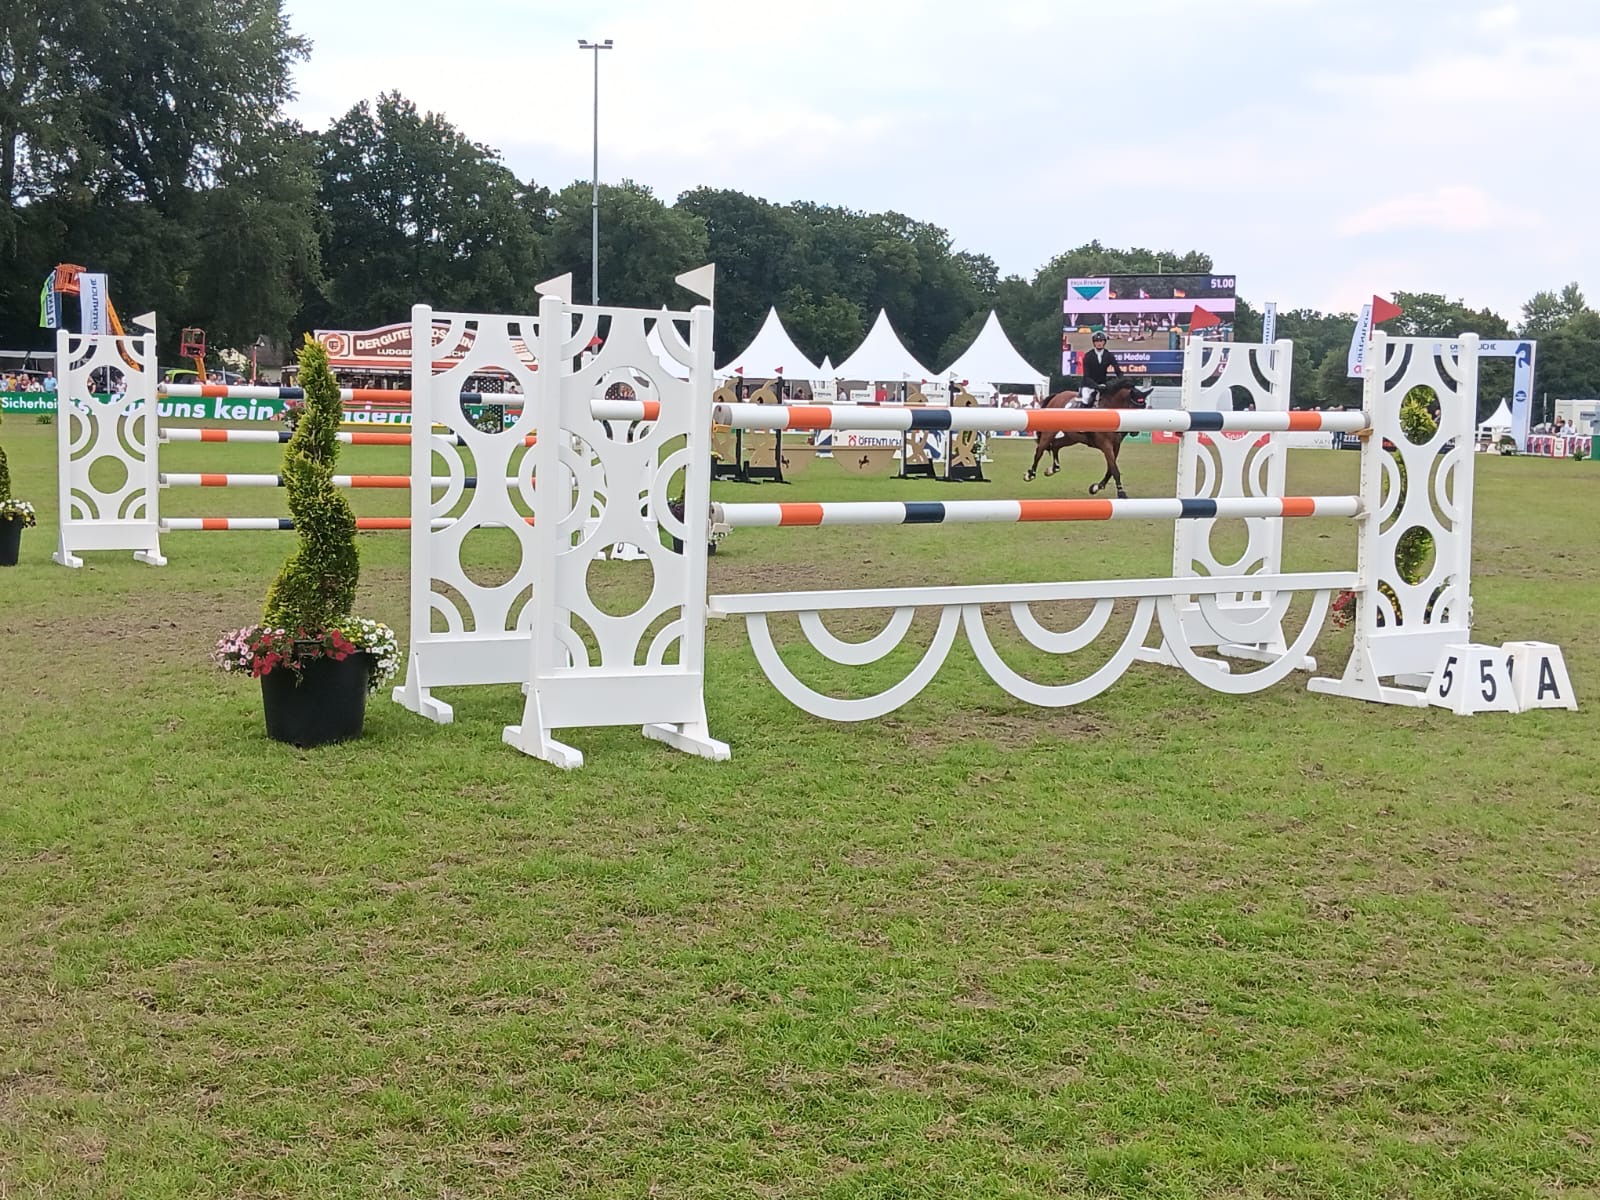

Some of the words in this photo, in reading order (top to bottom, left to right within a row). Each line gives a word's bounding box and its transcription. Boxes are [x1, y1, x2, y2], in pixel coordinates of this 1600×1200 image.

[1210, 278, 1234, 289] 51.00
[356, 337, 381, 350] DER
[381, 328, 410, 346] GUTE
[157, 401, 206, 418] uns
[214, 397, 274, 421] kein
[1439, 656, 1458, 698] 5
[1480, 659, 1497, 702] 5
[1537, 656, 1561, 700] A
